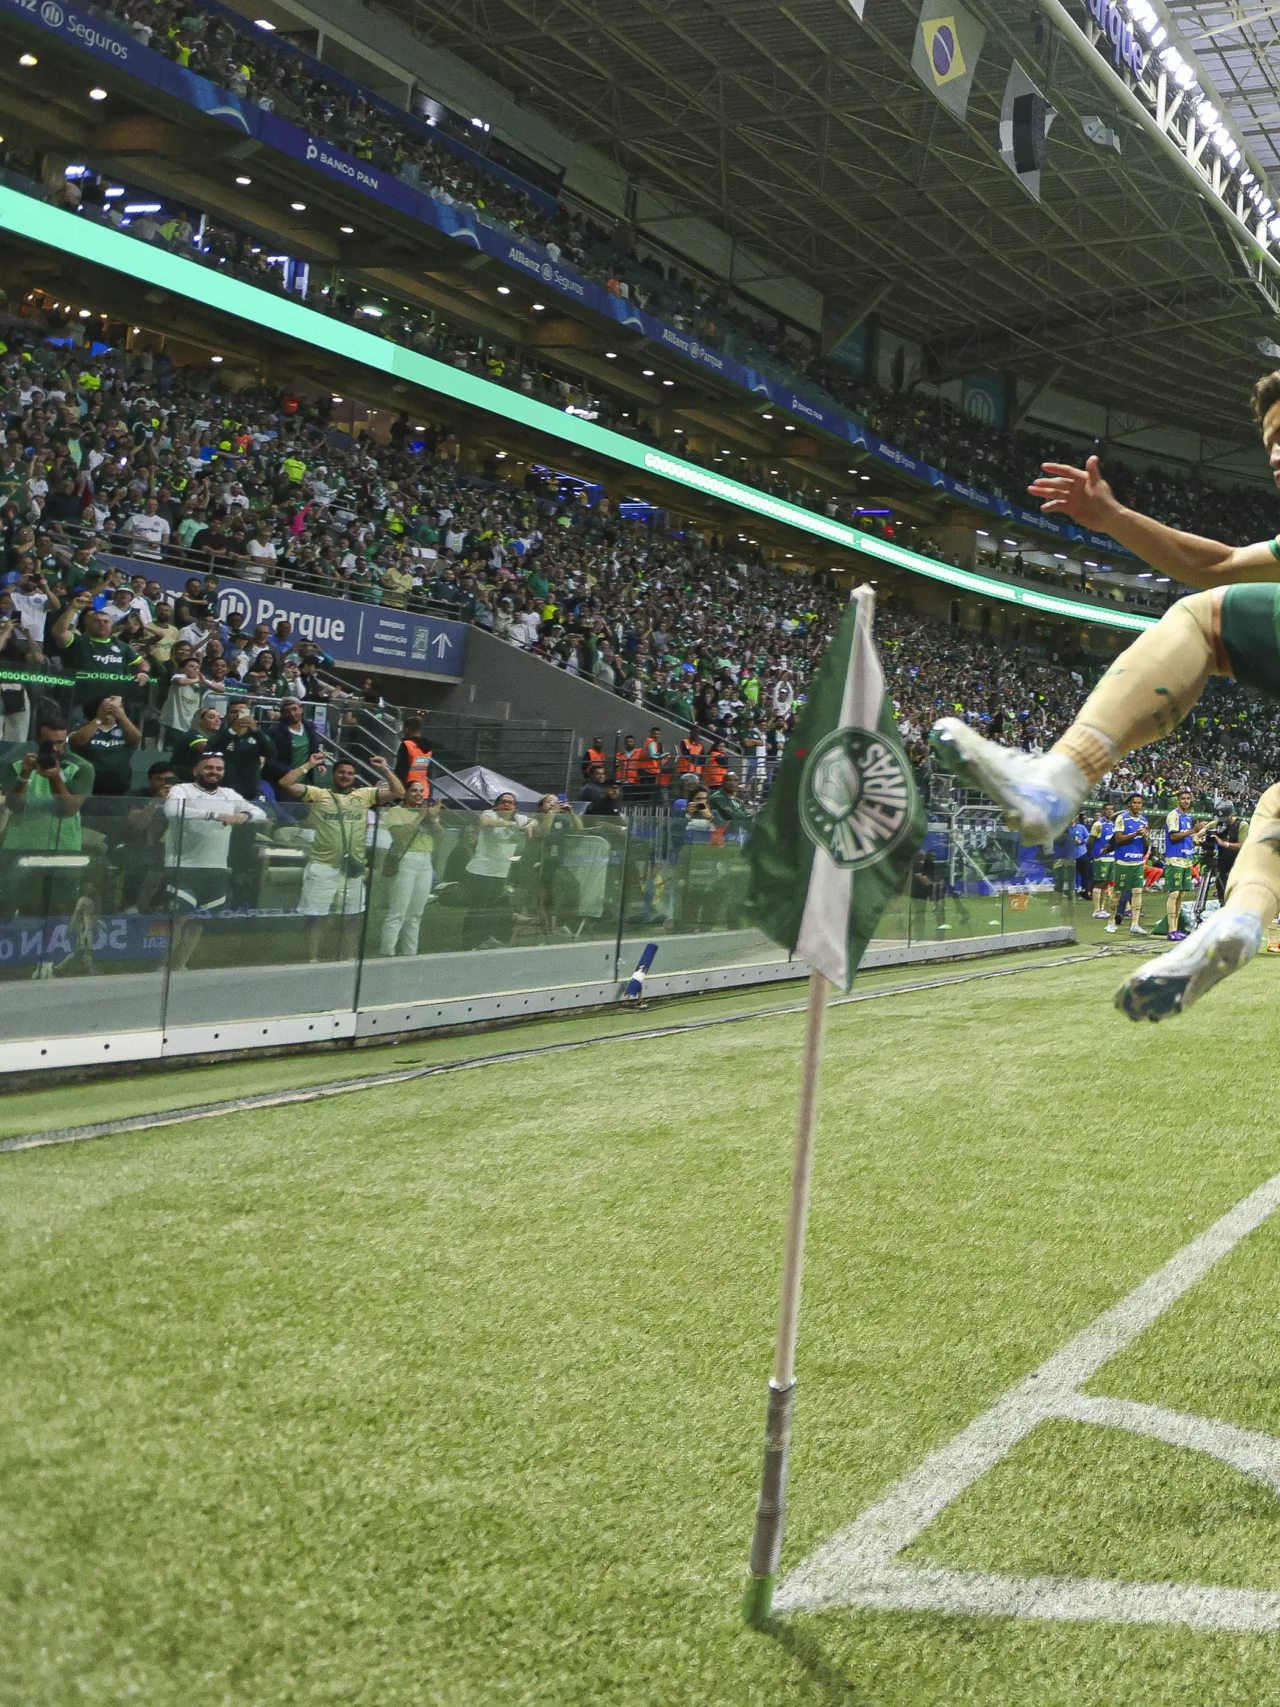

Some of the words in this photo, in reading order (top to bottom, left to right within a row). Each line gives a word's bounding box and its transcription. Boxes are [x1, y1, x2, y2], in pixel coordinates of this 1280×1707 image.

[66, 14, 129, 60] Seguros
[320, 152, 355, 177] BANCO
[356, 171, 379, 190] PAN
[508, 247, 540, 273] Allianz
[553, 270, 584, 296] Seguros
[256, 599, 345, 642] Parque
[829, 743, 908, 862] ALMEIRAS
